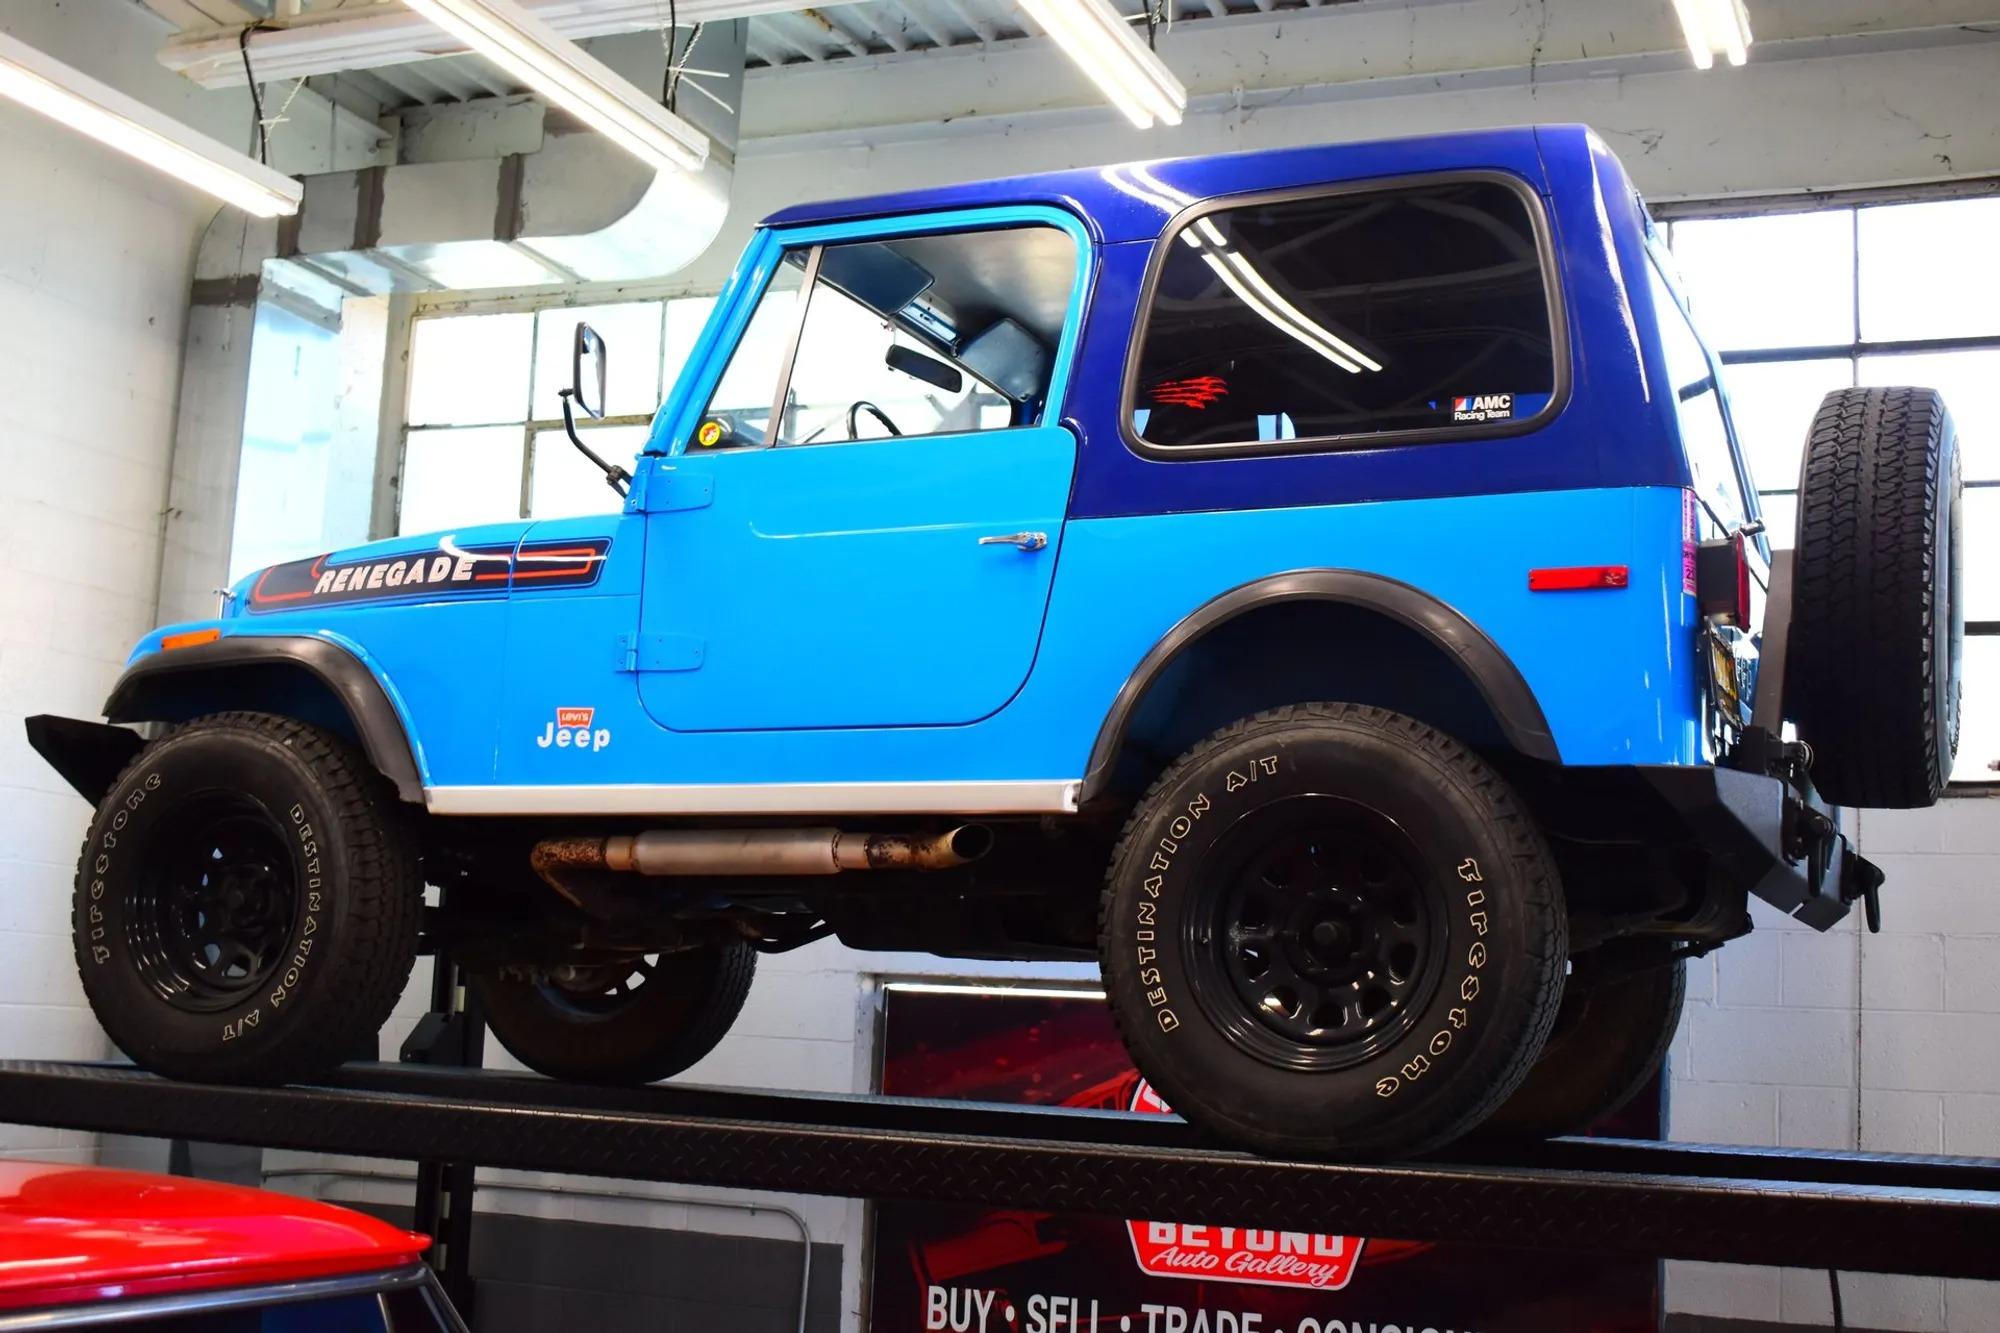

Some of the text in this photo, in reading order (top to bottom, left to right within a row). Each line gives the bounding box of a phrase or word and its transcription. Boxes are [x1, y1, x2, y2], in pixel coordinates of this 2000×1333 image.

[1454, 409, 1510, 421] Racing Team
[1472, 395, 1511, 410] AMC
[314, 556, 476, 595] RENEGADE
[537, 721, 610, 752] Jeep
[1137, 793, 1210, 1033] DESTINATION
[1226, 755, 1278, 792] A/T
[222, 803, 321, 1041] DESTINATION A/T
[1150, 1246, 1340, 1287] Auto Gallery
[927, 1285, 996, 1333] BUY
